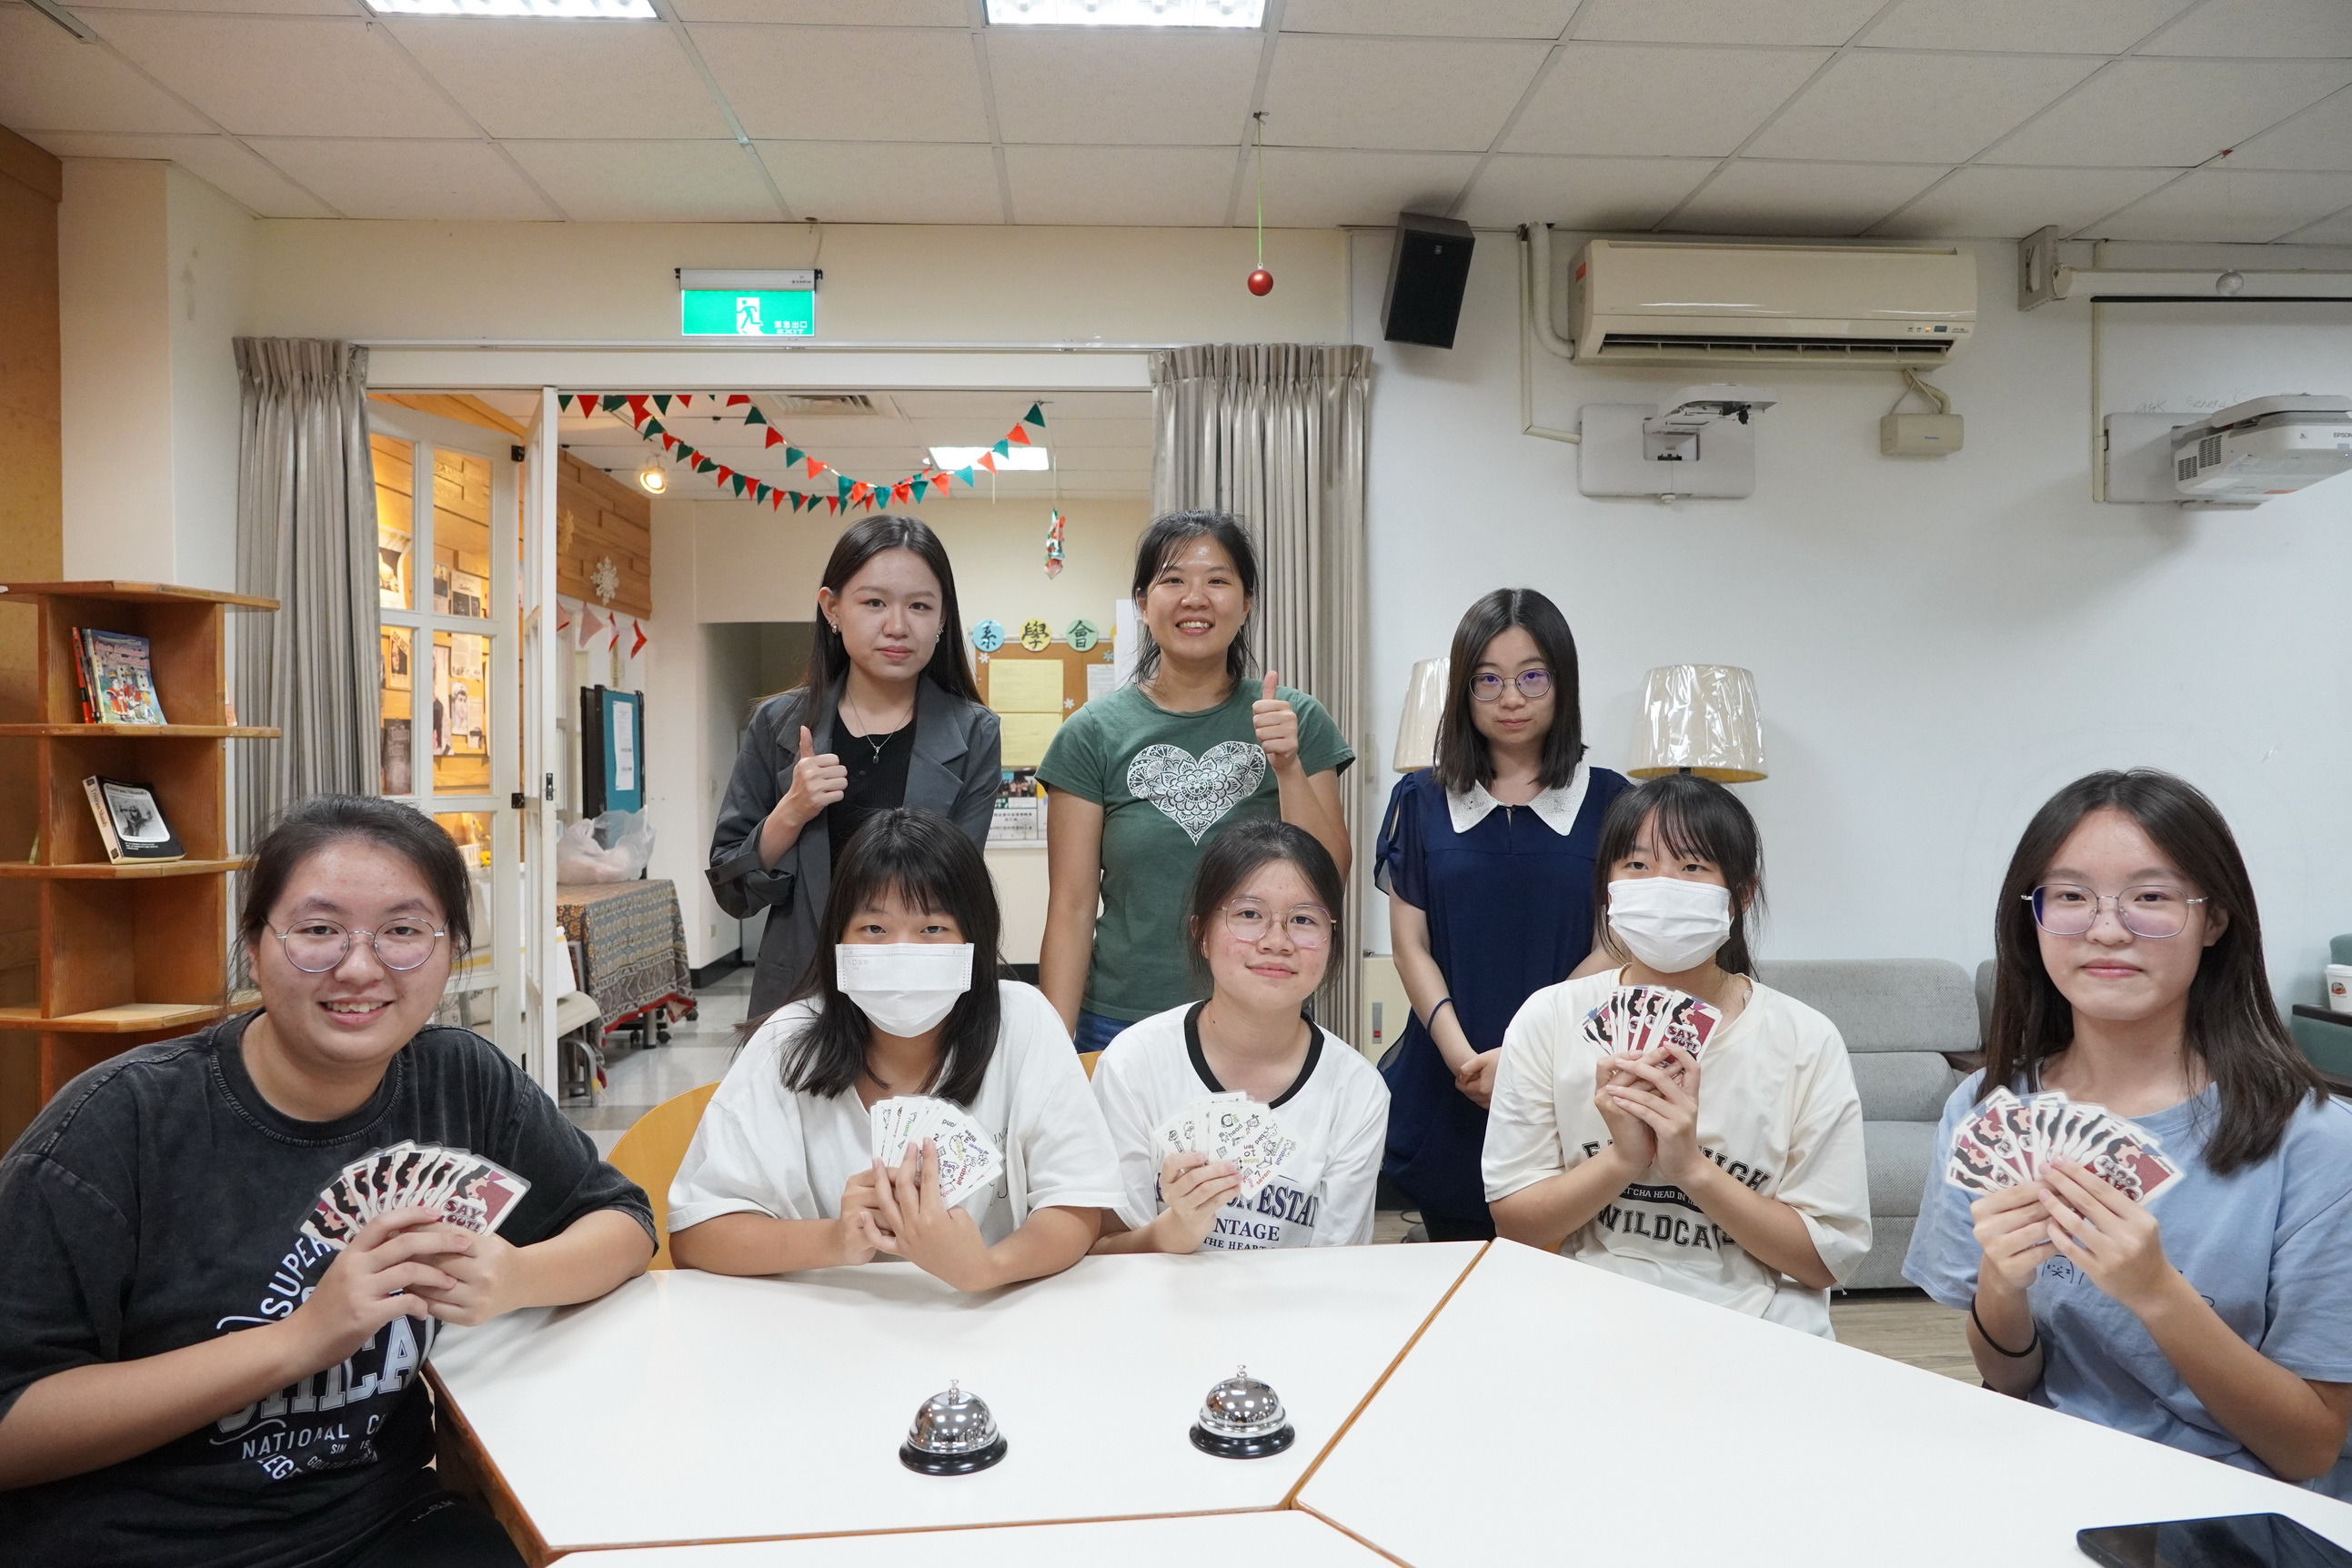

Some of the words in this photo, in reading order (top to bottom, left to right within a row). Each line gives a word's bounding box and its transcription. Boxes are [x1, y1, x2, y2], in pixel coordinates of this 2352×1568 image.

[1666, 1025, 1696, 1040] SAY
[941, 1119, 957, 1128] and
[1228, 1123, 1243, 1138] head
[957, 1164, 968, 1186] rabbit
[1256, 1170, 1271, 1185] seven
[1623, 1186, 1652, 1198] T'CHA
[1653, 1190, 1675, 1200] HEAD
[1677, 1192, 1686, 1201] IN
[444, 1199, 487, 1221] SAY
[1228, 1241, 1266, 1251] HEA
